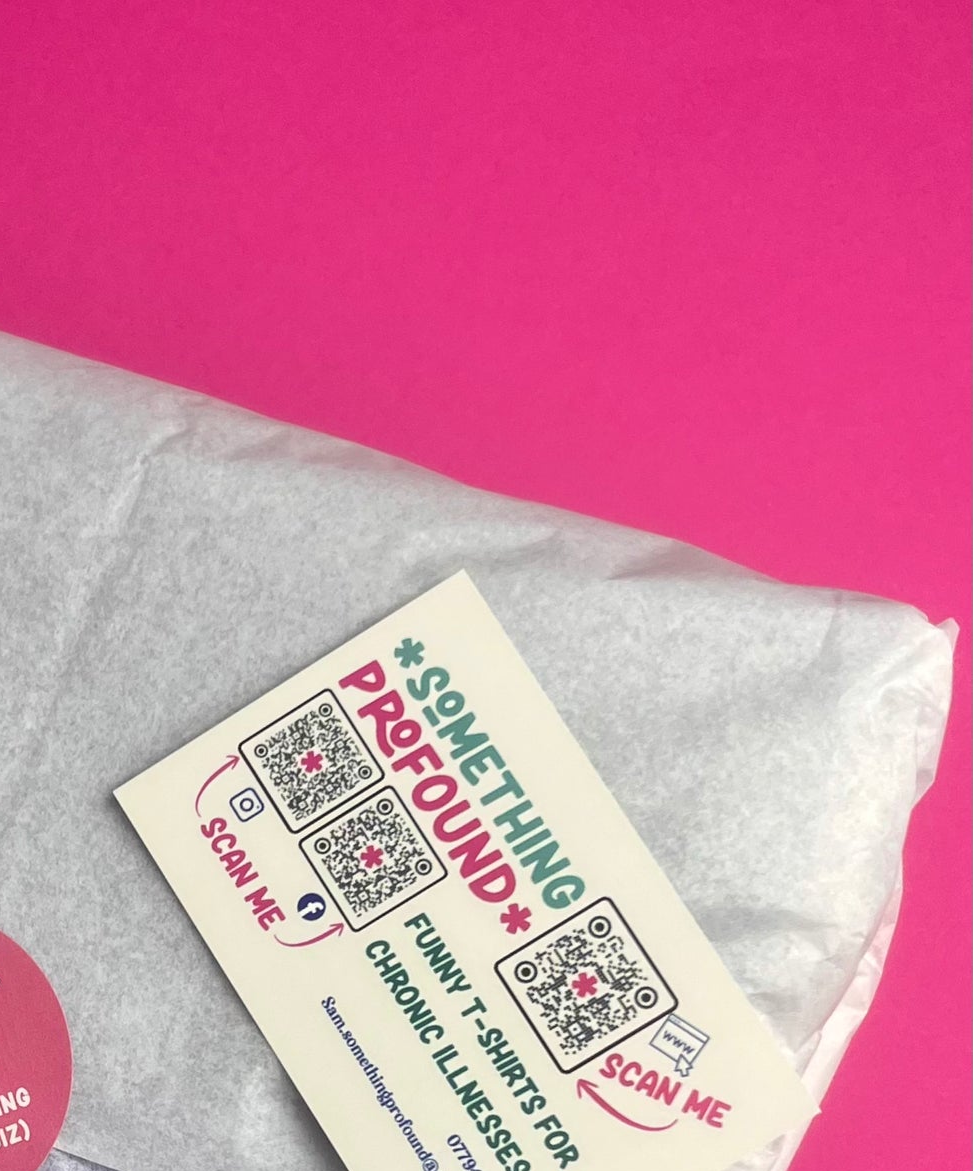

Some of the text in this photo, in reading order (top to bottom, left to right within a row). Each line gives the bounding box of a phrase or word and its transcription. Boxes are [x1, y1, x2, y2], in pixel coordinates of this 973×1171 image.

[201, 817, 286, 931] SCAN ME
[365, 940, 444, 1044] CHRONIC
[404, 912, 580, 1169] FUNNY T-SHIRTS FOR
[599, 1053, 731, 1128] SCAN ME
